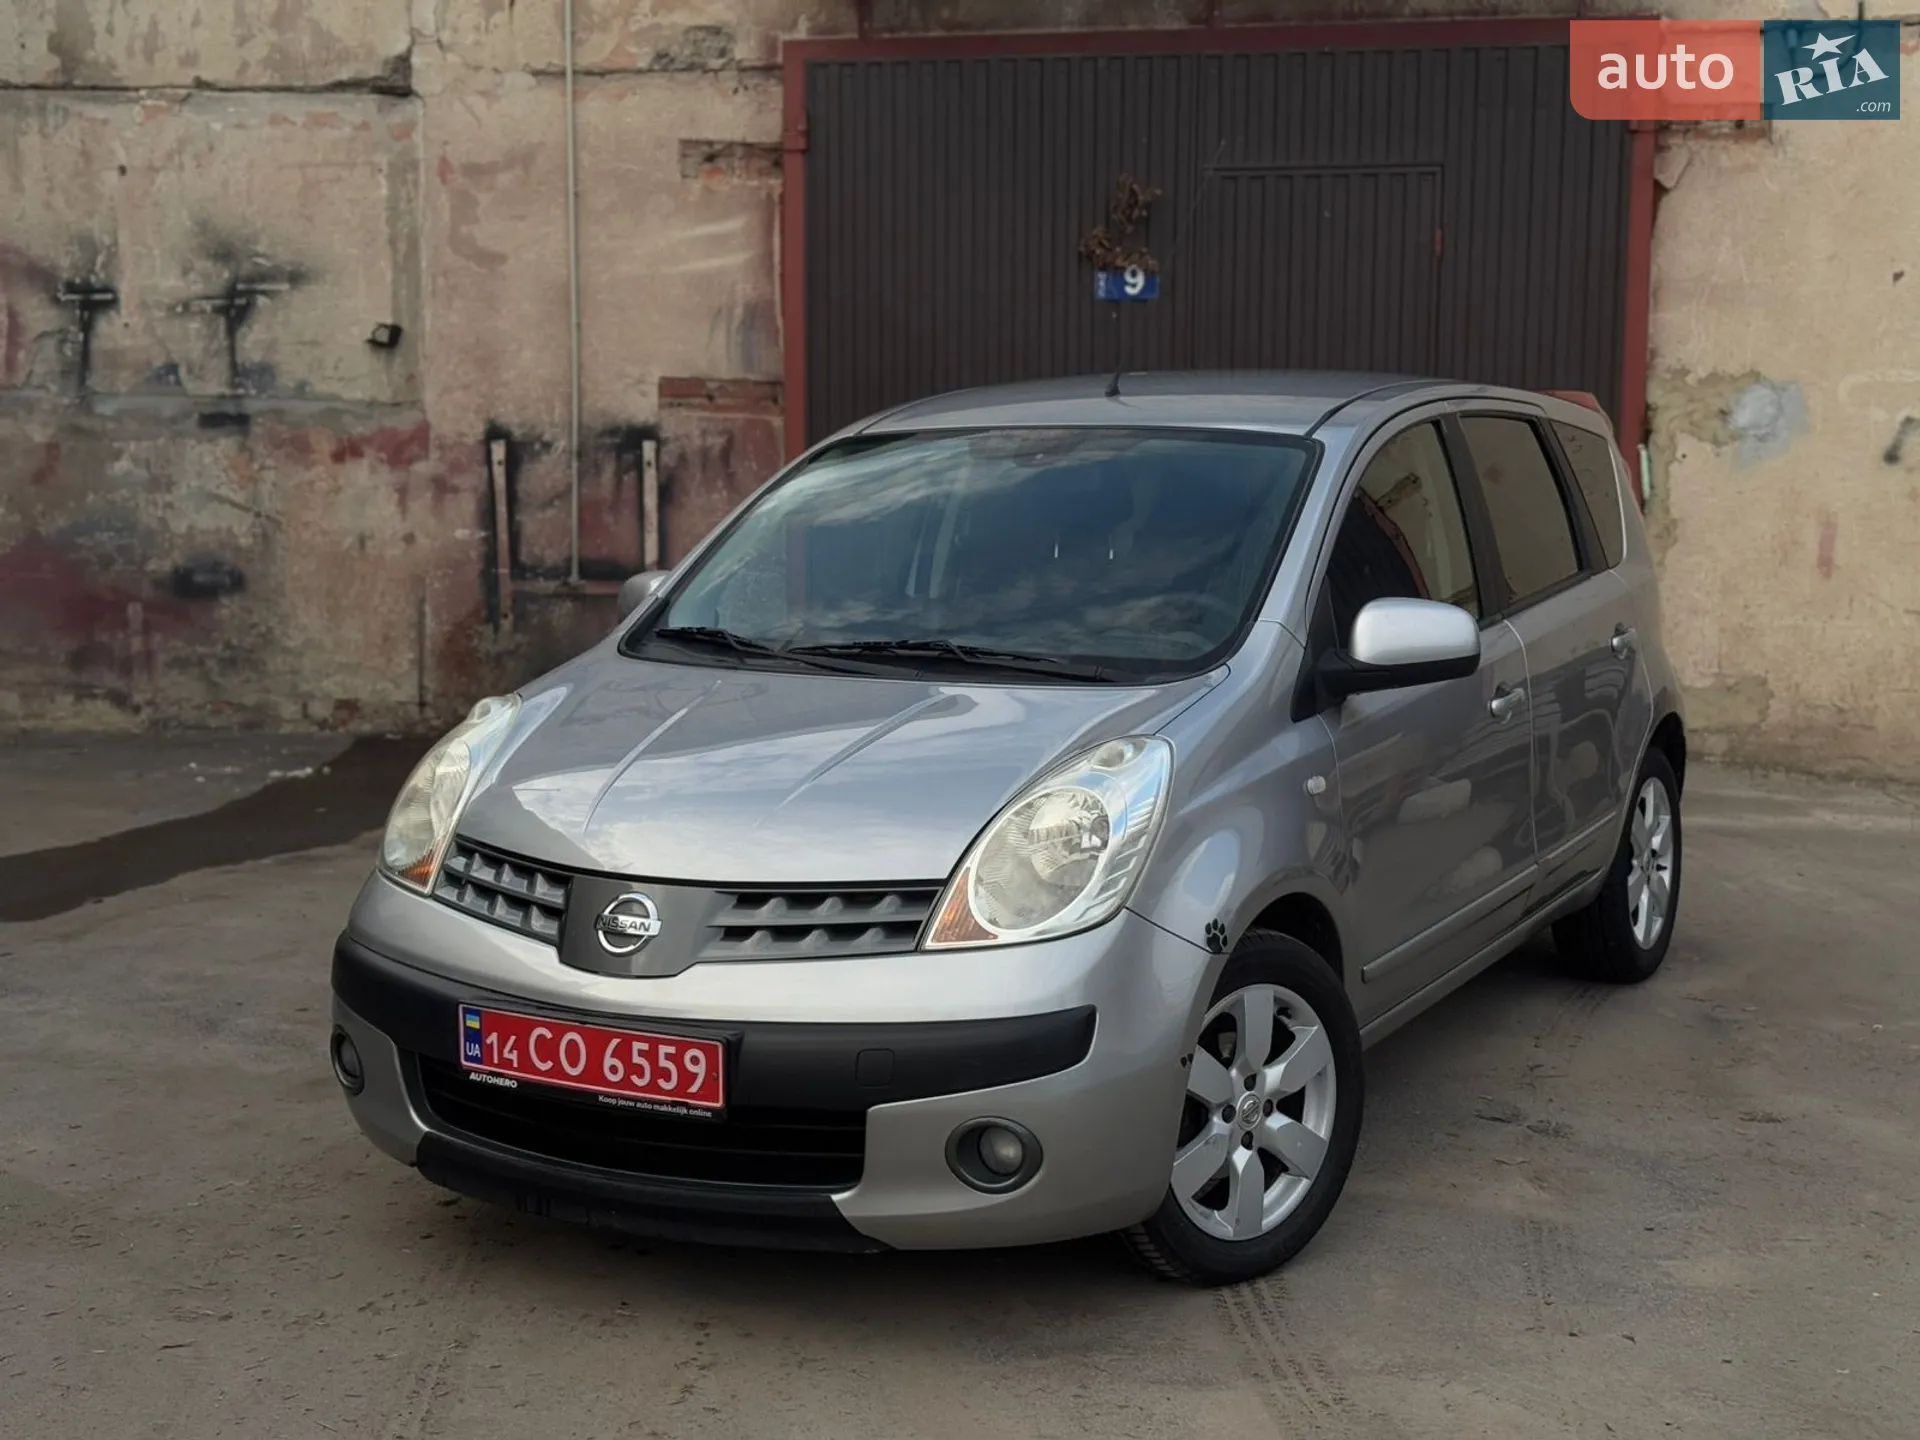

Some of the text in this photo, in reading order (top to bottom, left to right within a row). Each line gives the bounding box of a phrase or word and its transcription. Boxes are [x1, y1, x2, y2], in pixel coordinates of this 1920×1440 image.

[1124, 264, 1145, 296] 9
[600, 914, 652, 933] NISSAN
[466, 1041, 481, 1058] UA
[485, 1027, 707, 1094] 14 CO 6559
[469, 1071, 518, 1089] AUTOHERO
[598, 1095, 713, 1118] Koop jouw auto makkelijk online
